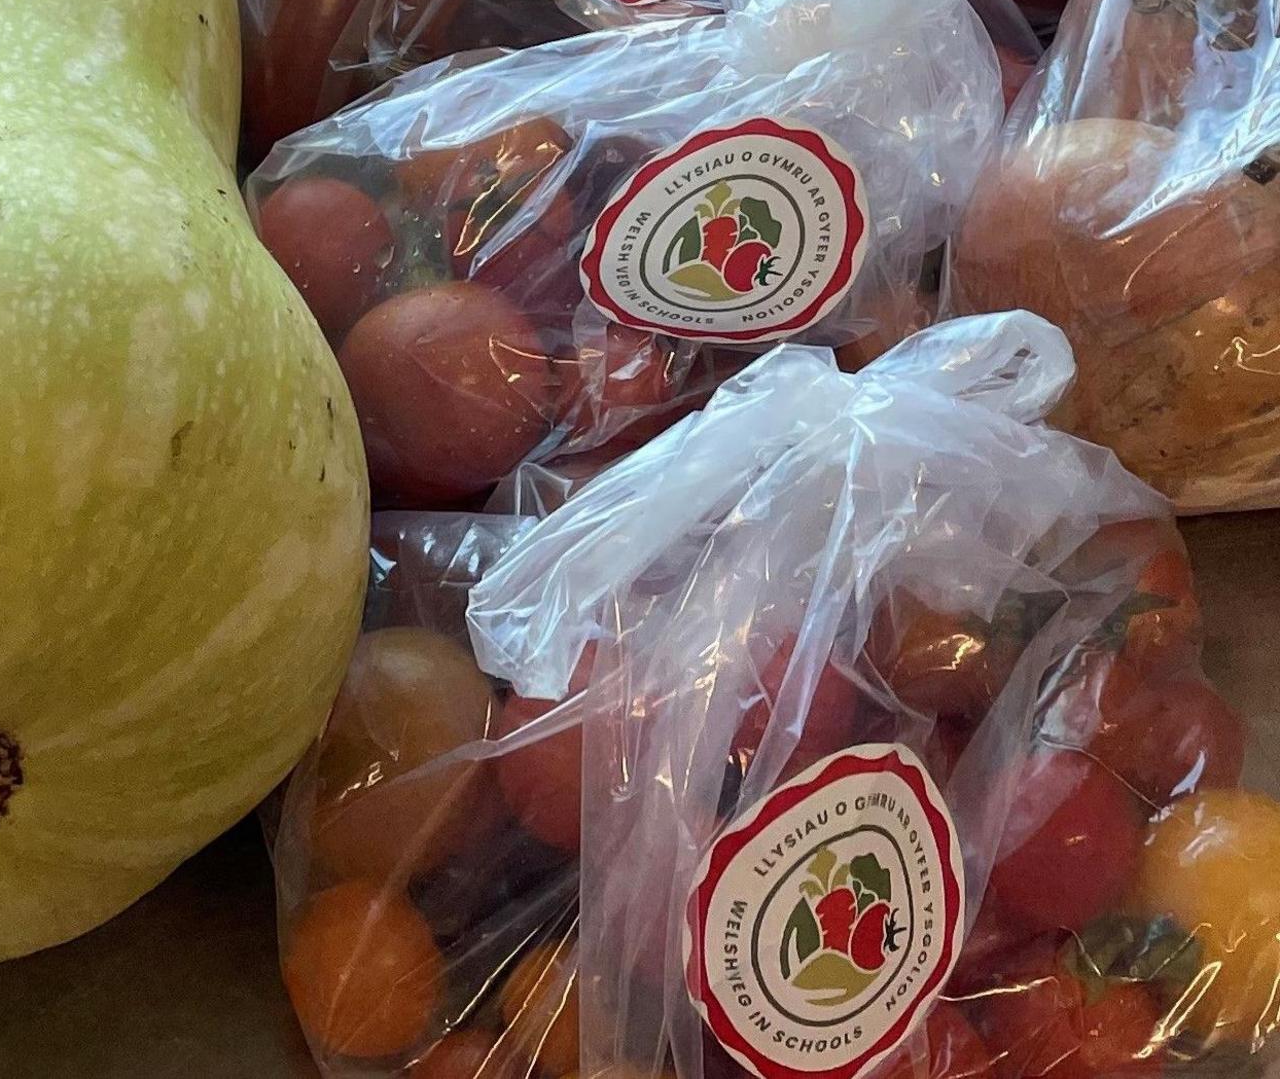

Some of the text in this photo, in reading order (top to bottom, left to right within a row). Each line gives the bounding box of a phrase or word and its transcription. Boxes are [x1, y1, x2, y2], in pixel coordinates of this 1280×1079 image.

[616, 211, 714, 324] WELSH VEG IN SCHOOLS
[664, 152, 830, 322] LLYSIAU O GYMRU AR GYFER YSGOLION
[753, 809, 829, 877] LLYSIAU
[835, 801, 847, 816] O
[897, 807, 910, 831] AR
[910, 831, 930, 894] GYFER
[724, 900, 748, 972] WELSH
[749, 1011, 771, 1032] IN
[773, 1026, 863, 1053] SCHOOLS
[886, 903, 934, 1011] YSGOLION
